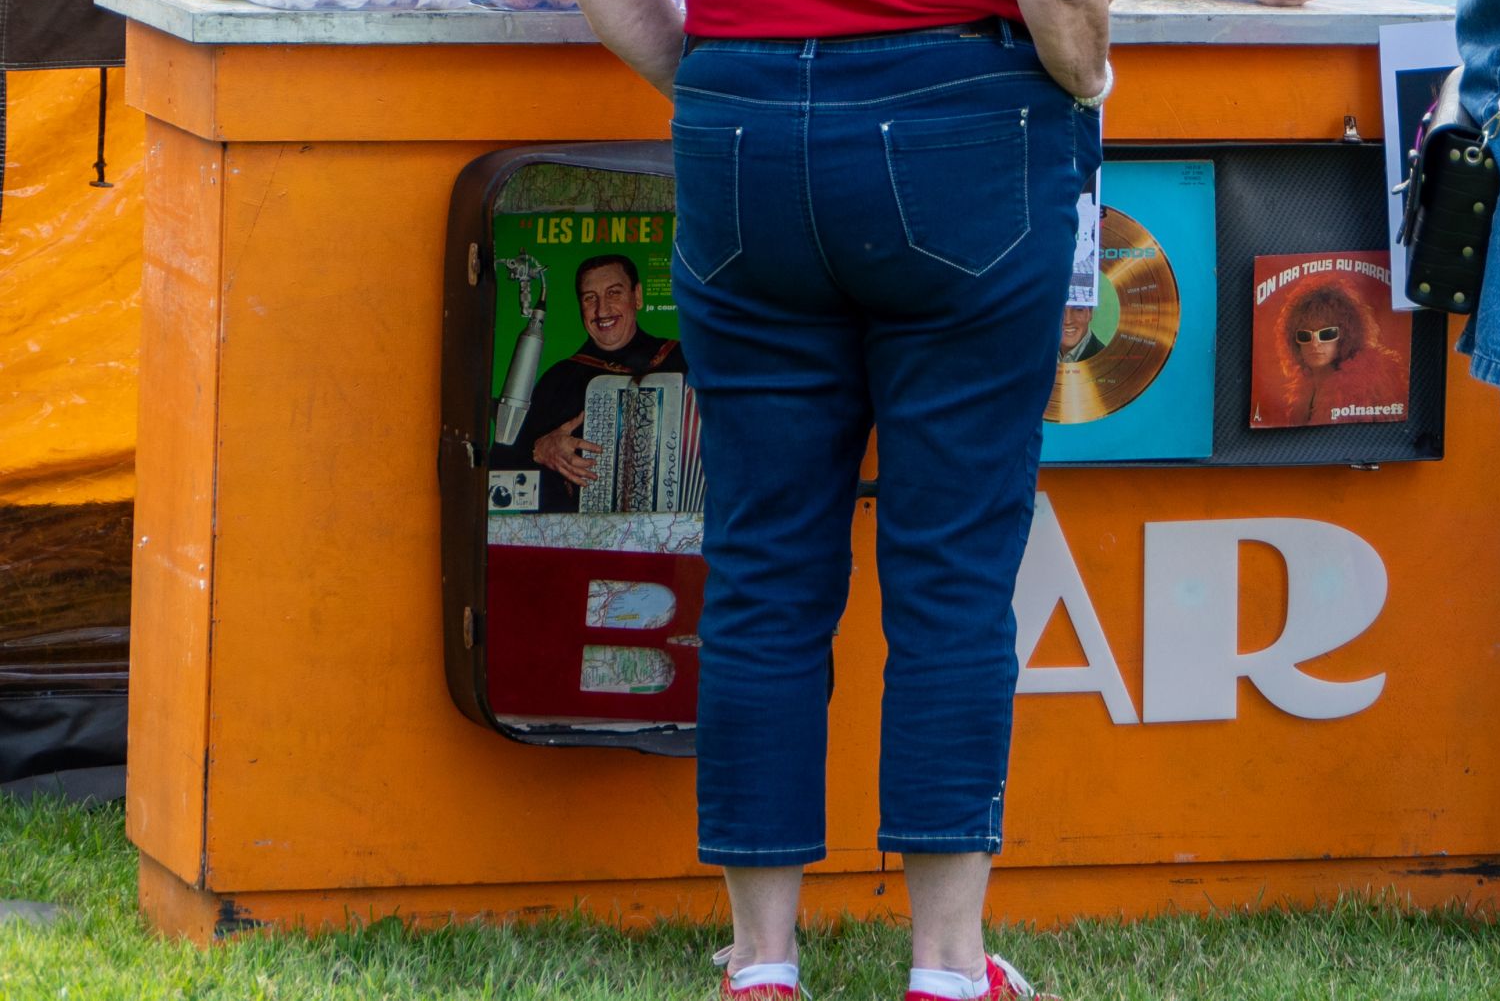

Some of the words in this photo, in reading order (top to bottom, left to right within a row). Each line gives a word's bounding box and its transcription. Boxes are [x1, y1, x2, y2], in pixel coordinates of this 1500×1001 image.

[581, 216, 665, 244] DANSES
[1256, 276, 1276, 305] ON
[1279, 266, 1300, 286] IRA
[1302, 259, 1333, 275] TOUS
[1336, 259, 1352, 271] AU
[657, 304, 678, 312] cour
[1331, 403, 1404, 420] polnareff
